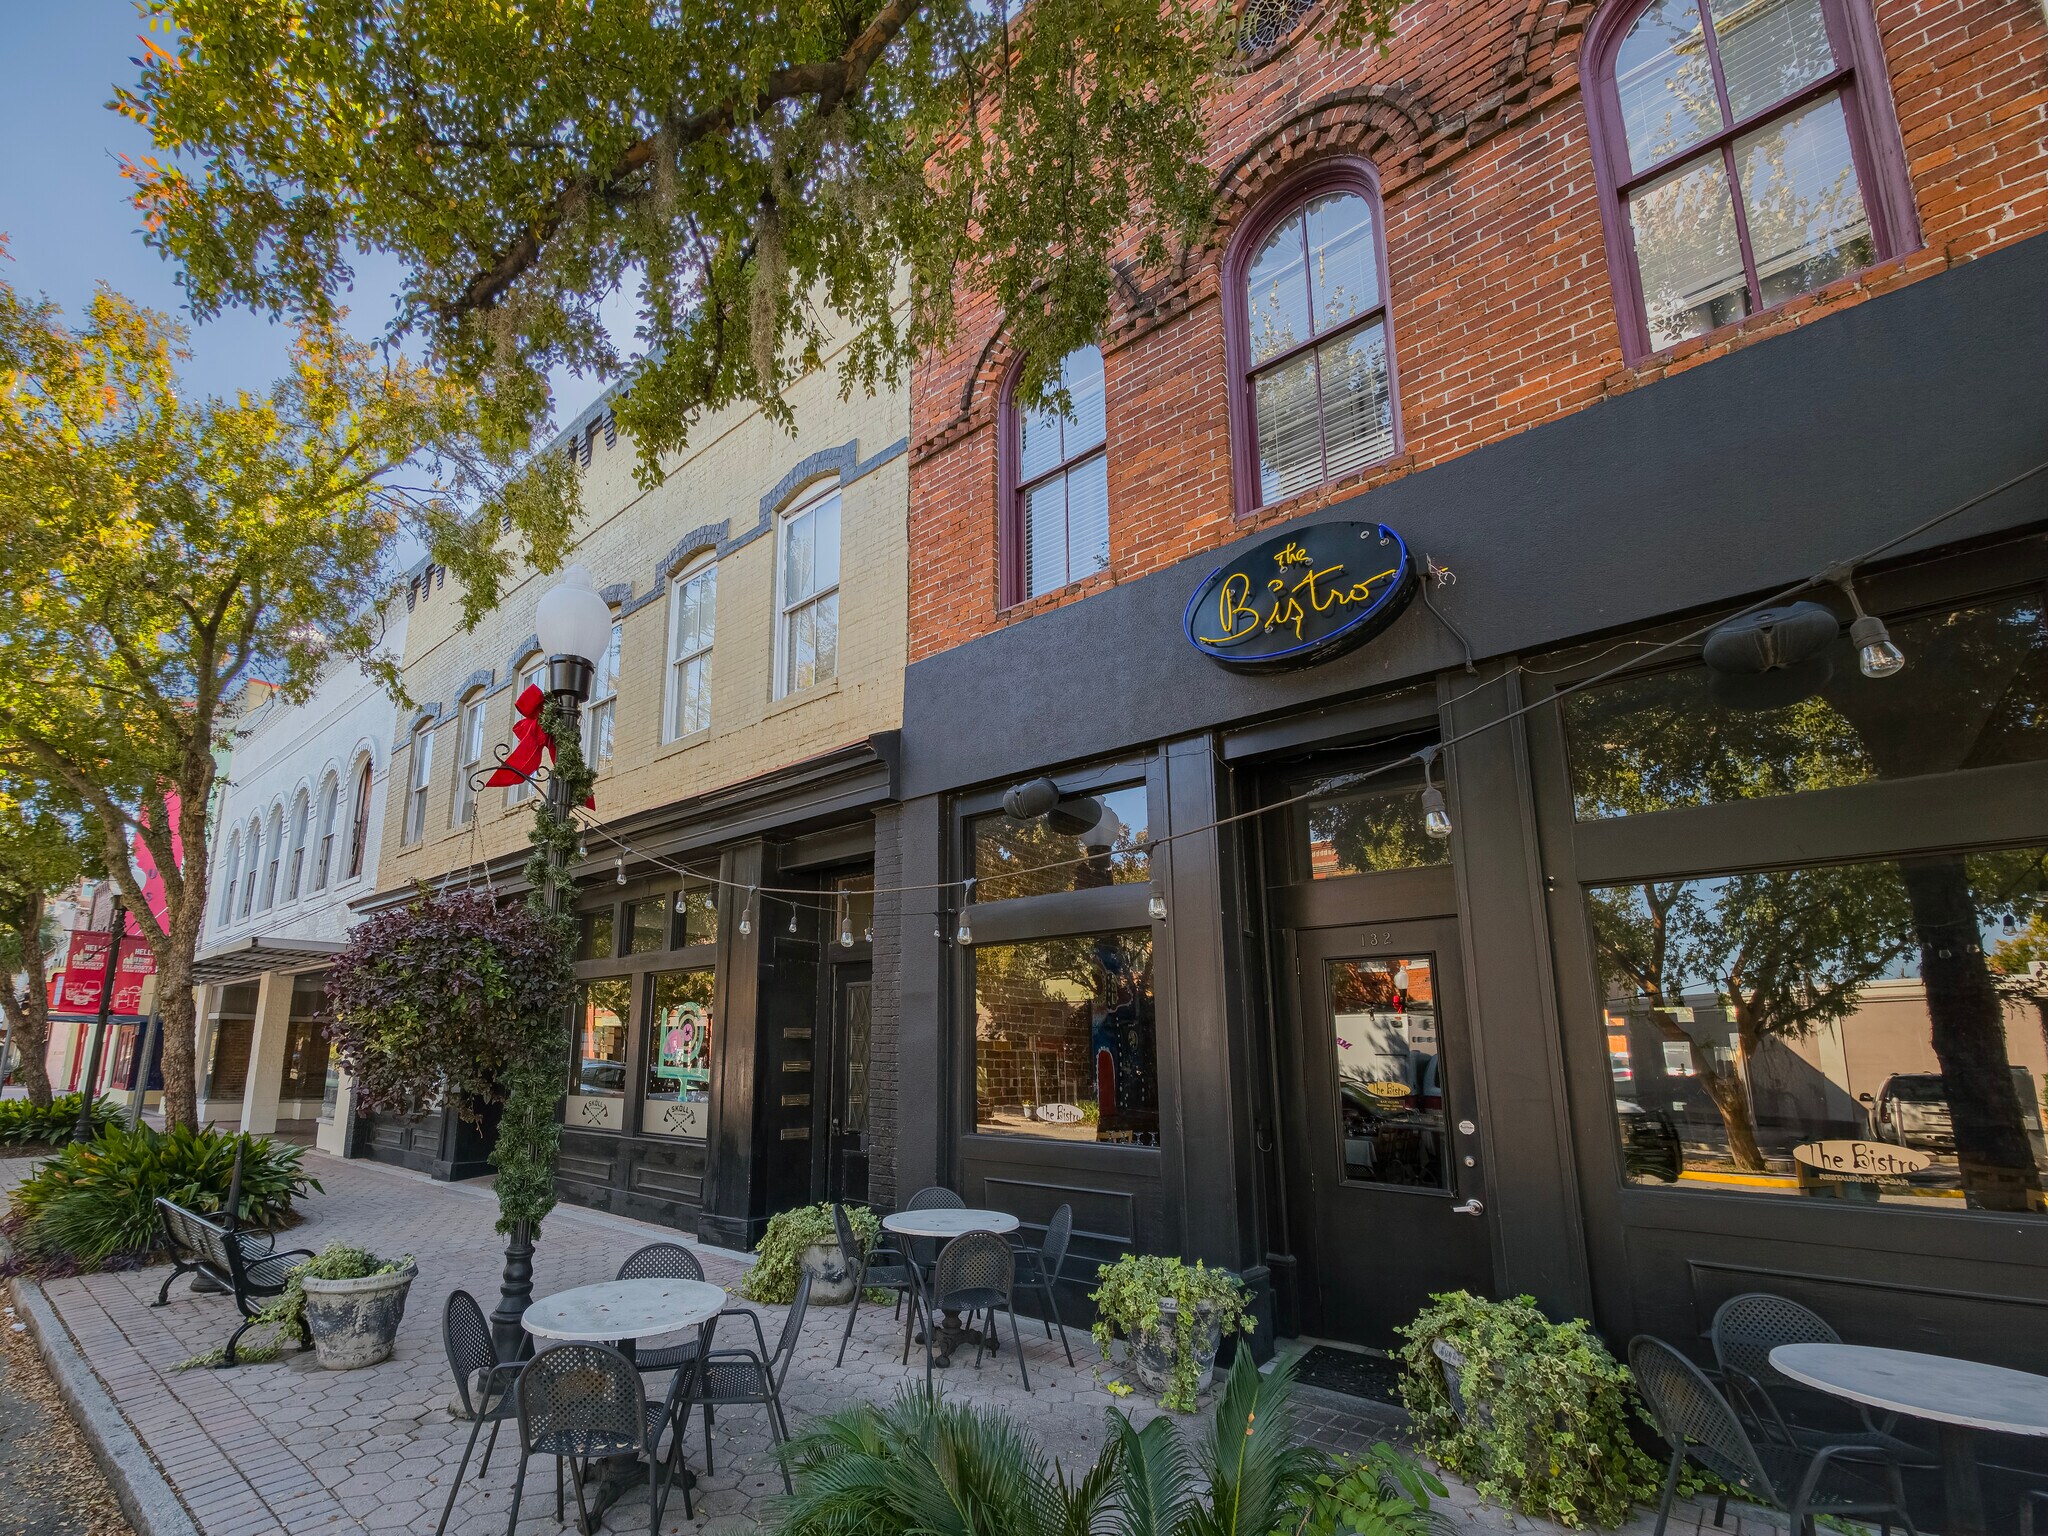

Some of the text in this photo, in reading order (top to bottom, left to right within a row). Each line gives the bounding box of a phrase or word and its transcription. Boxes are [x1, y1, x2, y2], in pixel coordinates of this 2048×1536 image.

[1199, 564, 1396, 643] Bistro
[1361, 932, 1392, 947] 132
[135, 948, 154, 956] HELL
[1804, 1141, 1920, 1173] The Bistro
[1818, 1173, 1877, 1184] RESTAURANT
